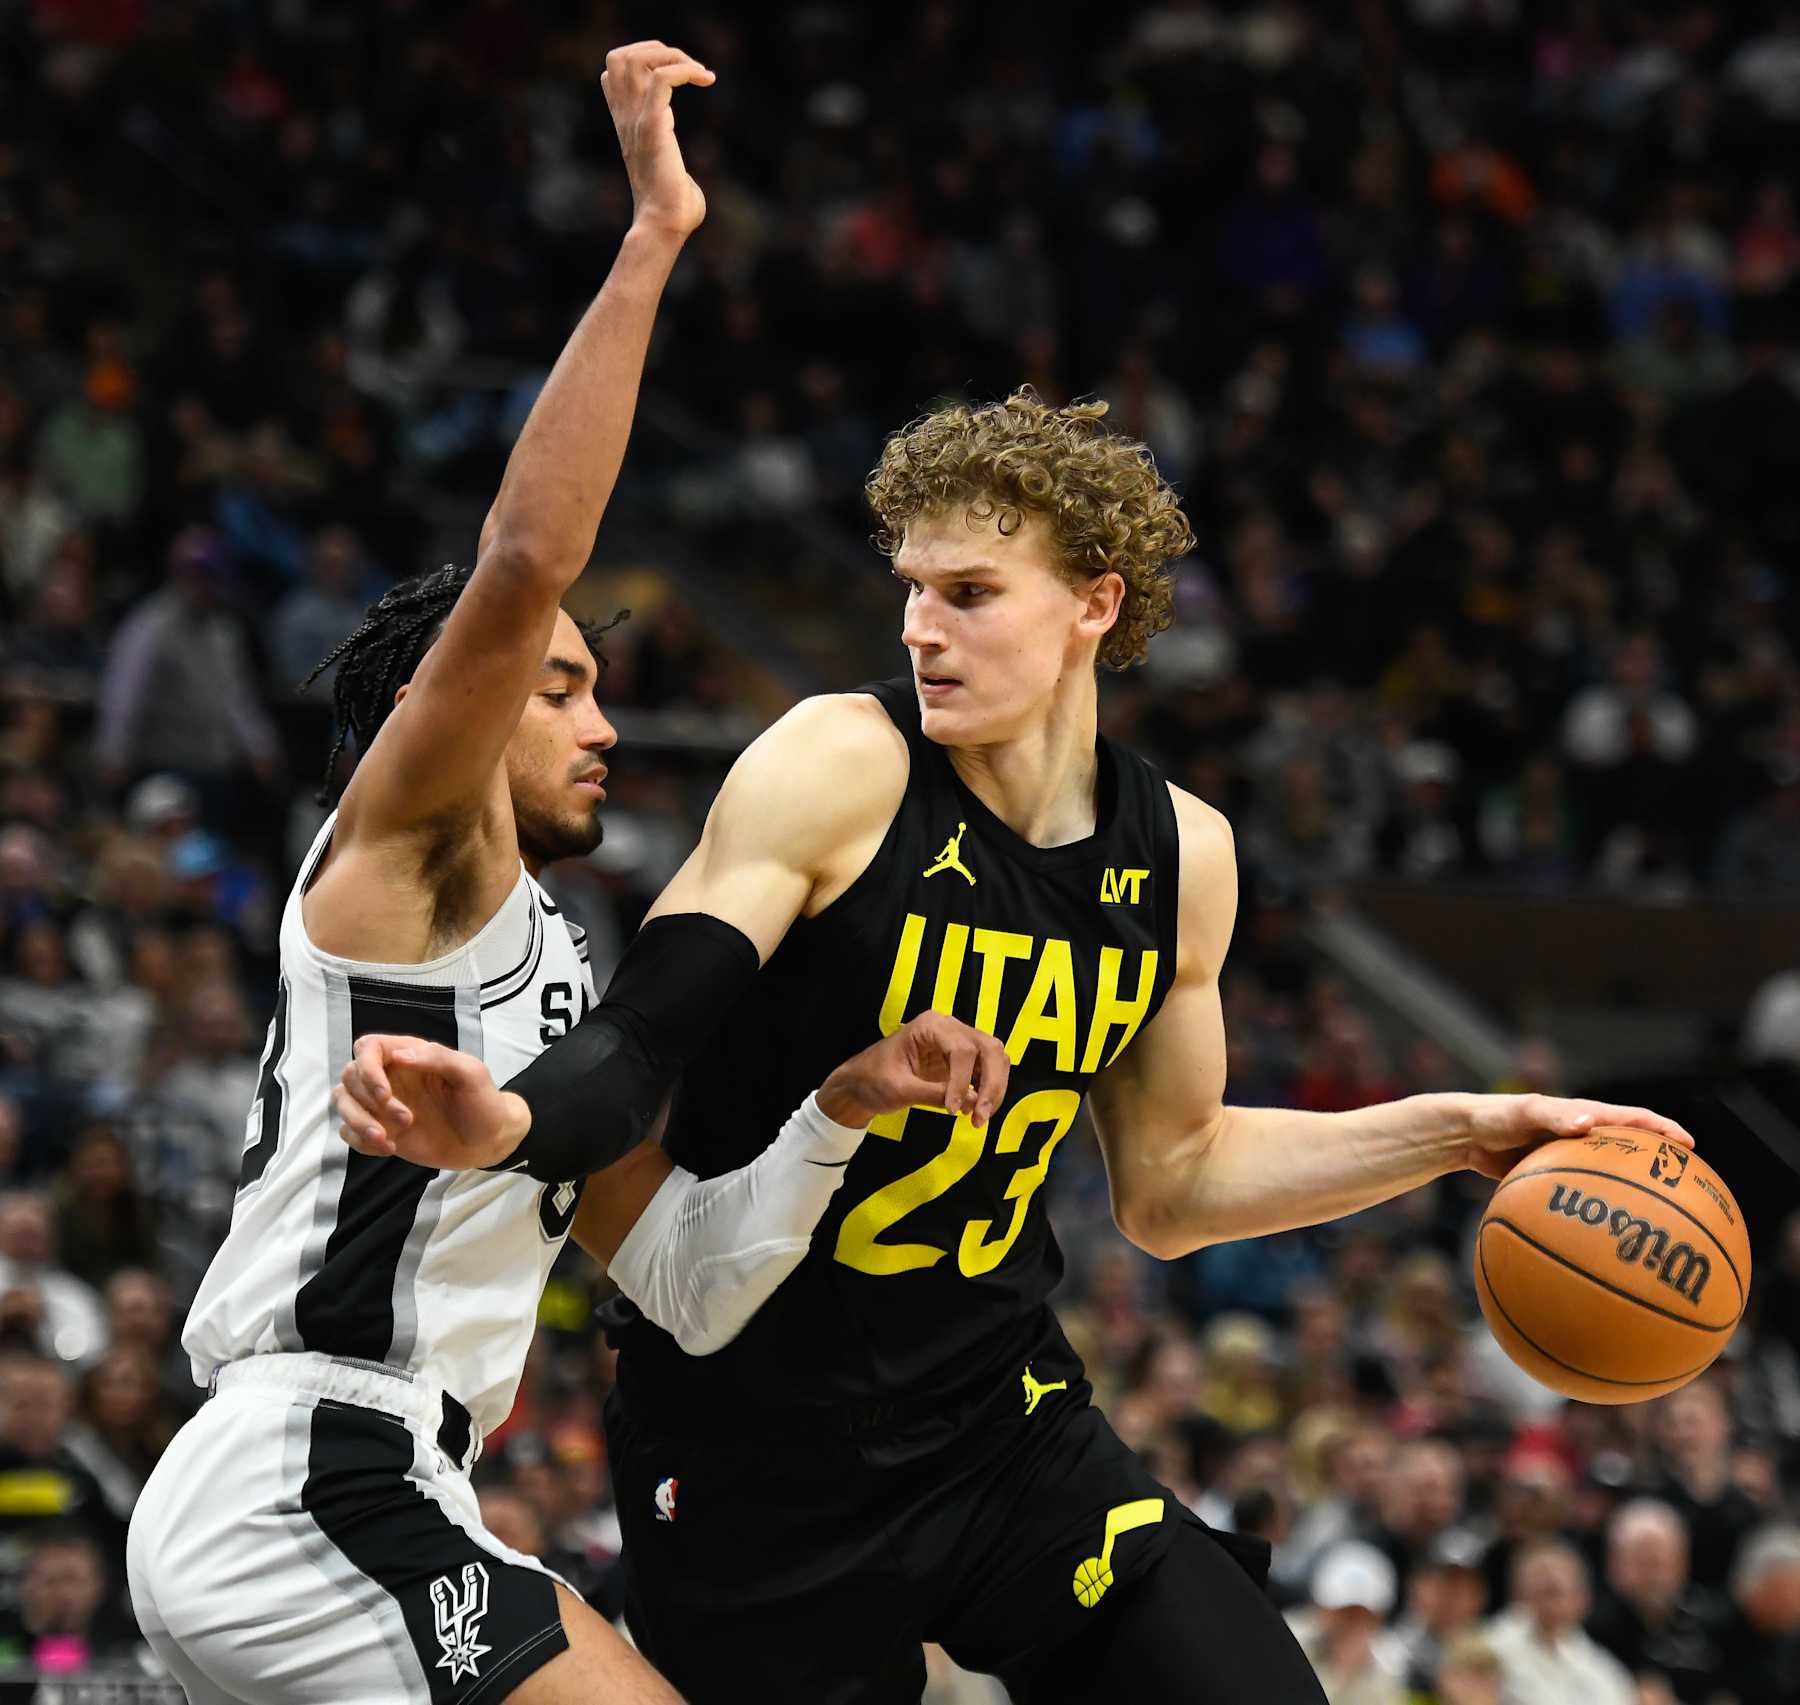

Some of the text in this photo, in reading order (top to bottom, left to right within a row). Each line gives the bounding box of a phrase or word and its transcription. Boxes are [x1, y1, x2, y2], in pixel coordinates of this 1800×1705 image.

[878, 912, 1159, 1074] UTAH
[833, 1088, 1081, 1278] 23
[1547, 1183, 1711, 1305] Wilson
